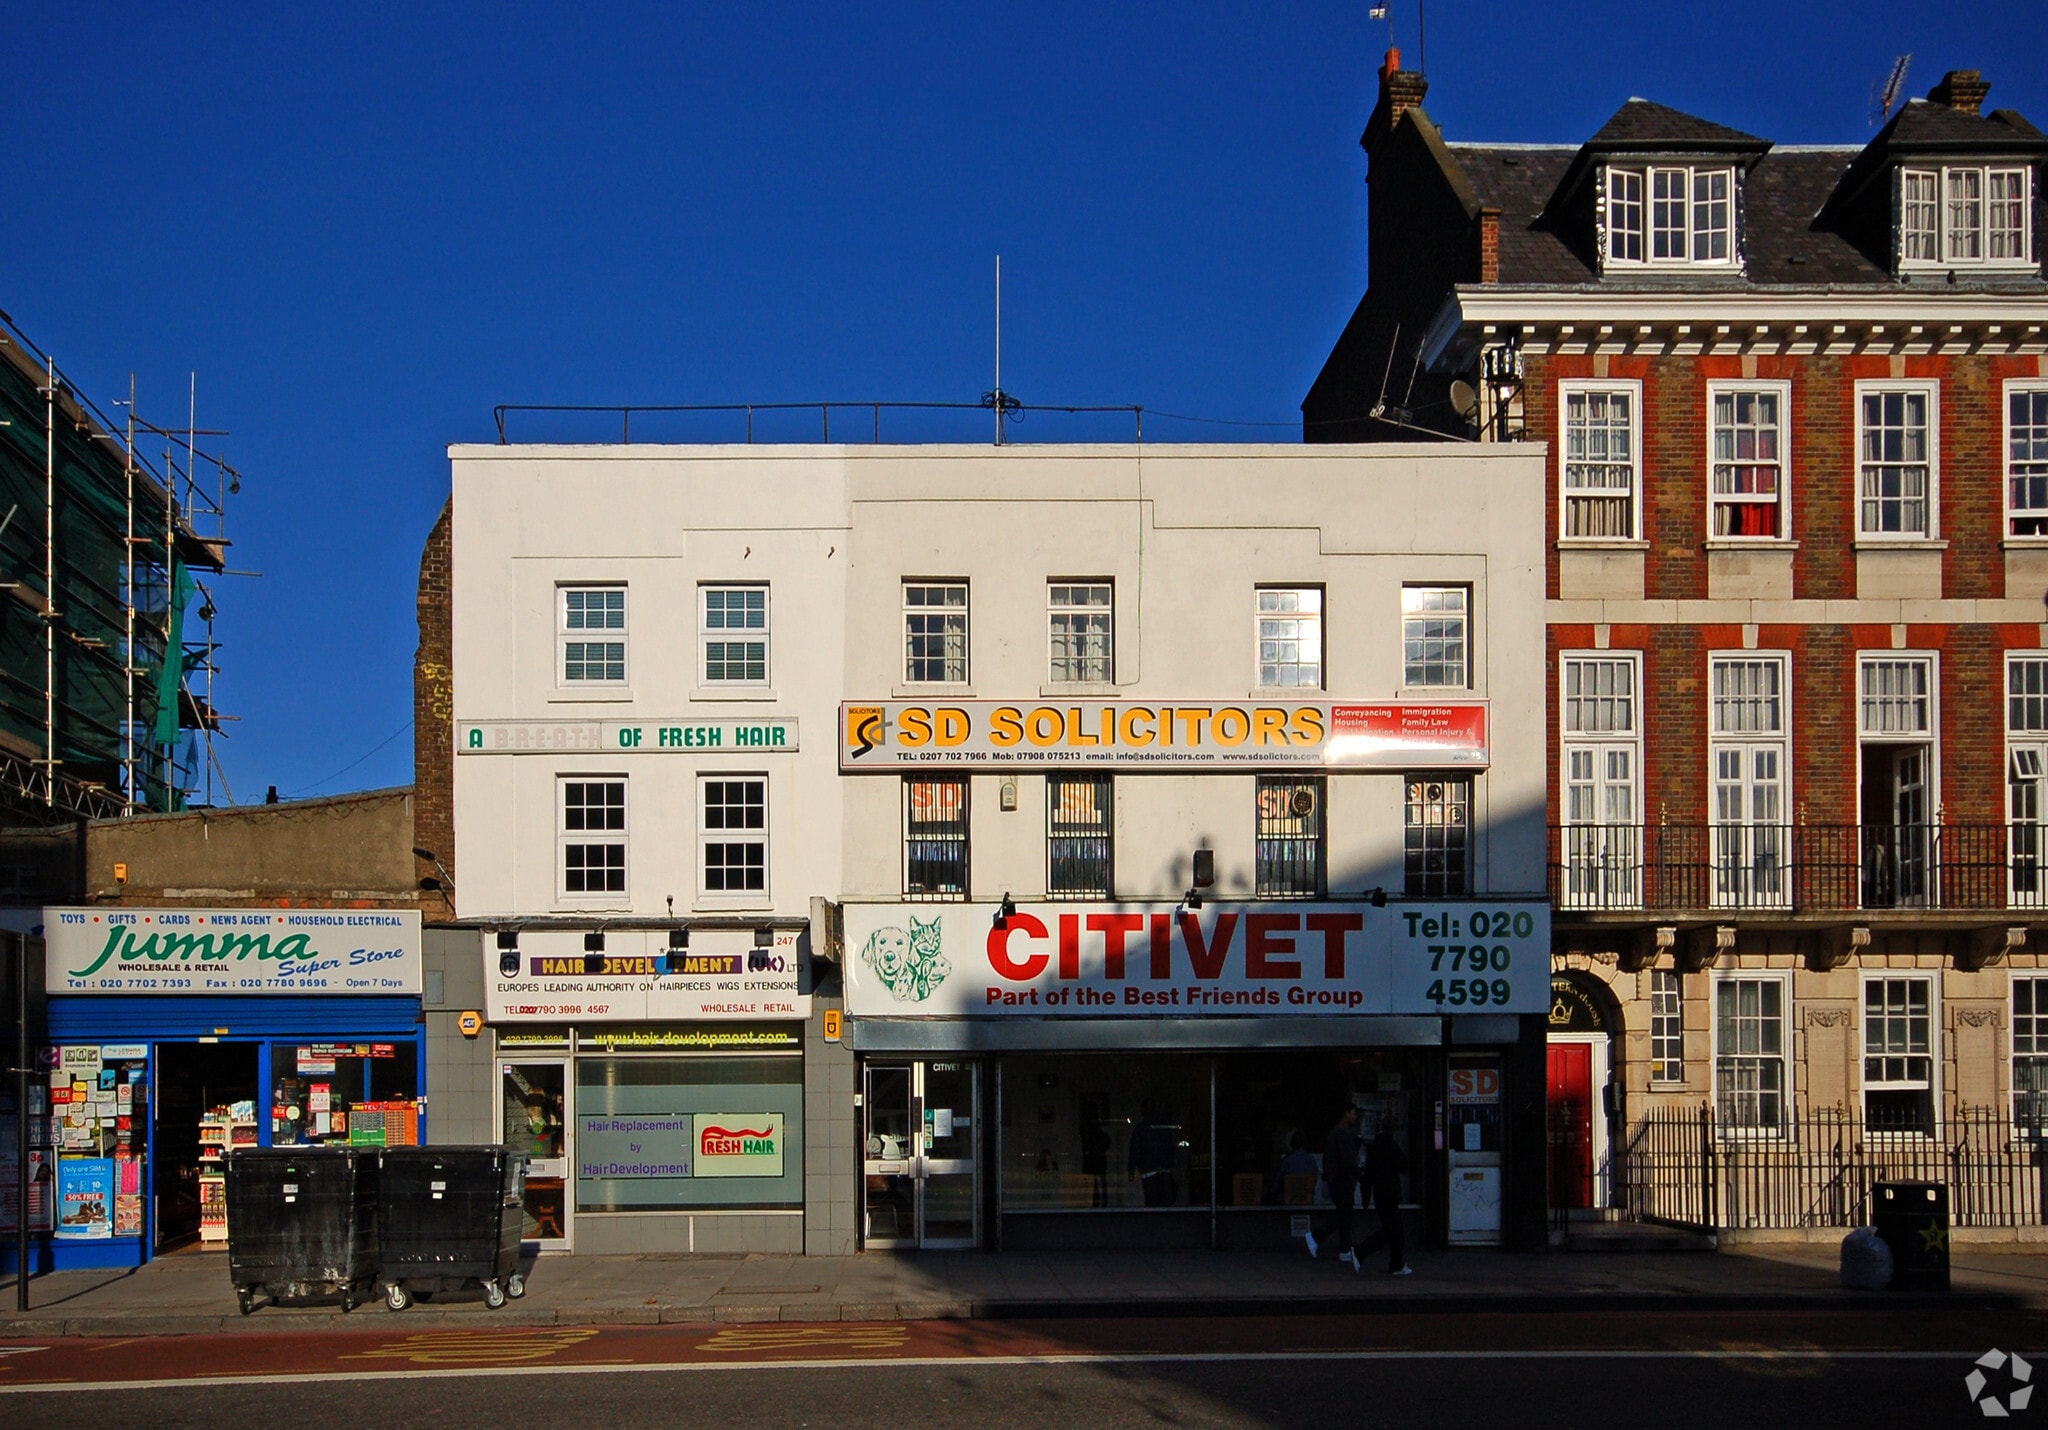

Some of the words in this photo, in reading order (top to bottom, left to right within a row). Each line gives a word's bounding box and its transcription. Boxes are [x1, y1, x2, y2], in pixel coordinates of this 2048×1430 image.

[1334, 708, 1392, 718] Conveyancing
[1402, 707, 1452, 717] Immigration
[897, 707, 972, 747] SD
[989, 707, 1325, 747] SOLICITORS
[1334, 718, 1369, 728] Housing
[1402, 717, 1428, 728] Family
[1431, 718, 1449, 727] Law
[469, 728, 483, 748] A
[619, 728, 642, 747] OF
[659, 727, 722, 747] FRESH
[735, 727, 785, 746] HAIR
[1402, 728, 1438, 737] Personal
[1440, 728, 1465, 738] Injury
[897, 753, 917, 761] TEL:
[920, 752, 942, 761] 0207
[945, 752, 962, 761] 702
[965, 752, 987, 761] 7966
[992, 752, 1015, 761] Mob:
[1017, 752, 1045, 761] 07908
[1048, 752, 1081, 761] 075213
[1086, 752, 1114, 761] email:
[1116, 751, 1215, 761] info@sdsolicitors.com
[60, 914, 85, 924] TOYS
[108, 914, 137, 925] GIFTS
[159, 914, 191, 925] CARDS
[211, 915, 238, 926] NEWS
[241, 915, 272, 926] AGENT
[288, 915, 345, 926] HOUSEHOLD
[347, 916, 402, 927] ELECTRICAL
[1403, 912, 1460, 938] Tel:
[1469, 911, 1534, 938] 020
[777, 936, 794, 946] 247
[986, 912, 1363, 981] CITIVET
[68, 924, 319, 978] Jumma
[277, 958, 341, 978] Super
[350, 946, 404, 966] Store
[542, 959, 585, 975] HAIR
[747, 953, 785, 974] (UK)
[786, 963, 804, 973] LTD
[1427, 945, 1511, 972] 7790
[118, 963, 182, 972] WHOLESALE
[184, 963, 192, 972] &
[195, 963, 230, 972] RETAIL
[100, 978, 123, 988] 020
[127, 978, 158, 988] 7702
[162, 978, 192, 988] 7393
[240, 978, 262, 988] 020
[266, 978, 295, 988] 7780
[299, 978, 328, 988] 9696
[345, 978, 370, 989] Open
[373, 978, 379, 988] 7
[381, 978, 403, 990] Days
[497, 982, 539, 993] EUROPES
[544, 982, 583, 992] LEADING
[586, 982, 635, 992] AUTHORITY
[639, 981, 654, 992] ON
[659, 981, 711, 992] HAIRPIECES
[717, 981, 740, 992] WIGS
[744, 981, 800, 991] EXTENSIONS
[986, 987, 1038, 1005] Part
[1046, 986, 1070, 1005] of
[1075, 986, 1116, 1005] the
[1124, 987, 1179, 1005] Best
[1187, 986, 1280, 1006] Friends
[1287, 986, 1363, 1008] Group
[1426, 979, 1511, 1006] 4599
[558, 1005, 582, 1014] 3996
[587, 1005, 609, 1014] 4567
[700, 1003, 756, 1013] WHOLESALE
[763, 1003, 795, 1013] RETAIL
[933, 1063, 961, 1072] CITIVET
[1452, 1070, 1499, 1095] SD
[29, 1124, 58, 1134] HONE
[587, 1120, 610, 1131] Hair
[612, 1120, 684, 1133] Replacement
[29, 1133, 60, 1143] ARDS
[630, 1143, 642, 1154] by
[744, 1140, 776, 1154] HAIR
[30, 1152, 44, 1164] 3p
